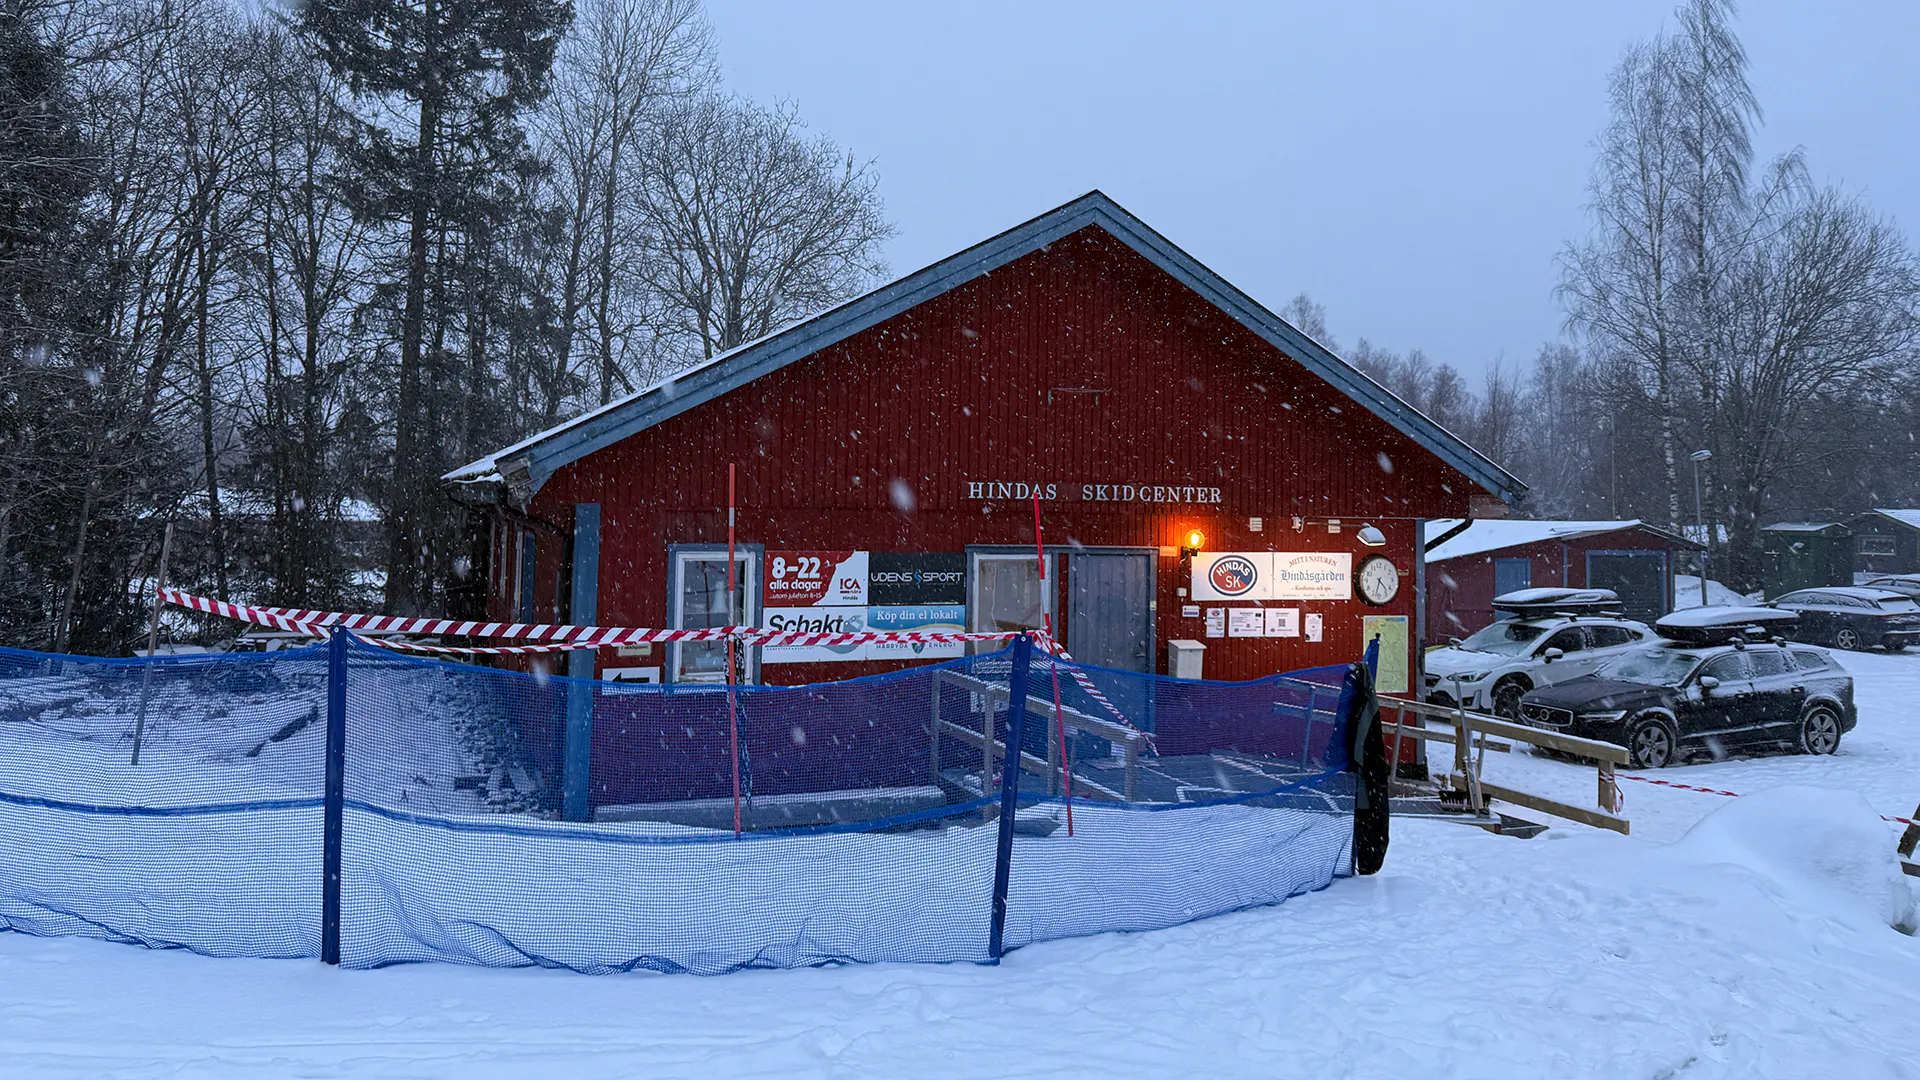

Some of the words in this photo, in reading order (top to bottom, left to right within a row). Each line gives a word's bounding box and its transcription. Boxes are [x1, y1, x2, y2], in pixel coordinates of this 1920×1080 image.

[1082, 484, 1222, 503] SKIDCENTER
[772, 557, 820, 578] 8-22
[1309, 556, 1338, 567] NATUREN
[870, 572, 912, 582] UDENS
[922, 572, 963, 582] SPORT
[1225, 575, 1241, 588] SK
[1281, 569, 1345, 583] Hindåsgården
[769, 579, 789, 590] alla
[791, 579, 822, 591] dagar
[840, 578, 861, 589] ICA
[877, 611, 897, 623] Köp
[900, 611, 915, 620] din
[918, 611, 927, 619] el
[930, 609, 958, 619] lokalt
[769, 614, 844, 633] Schakt
